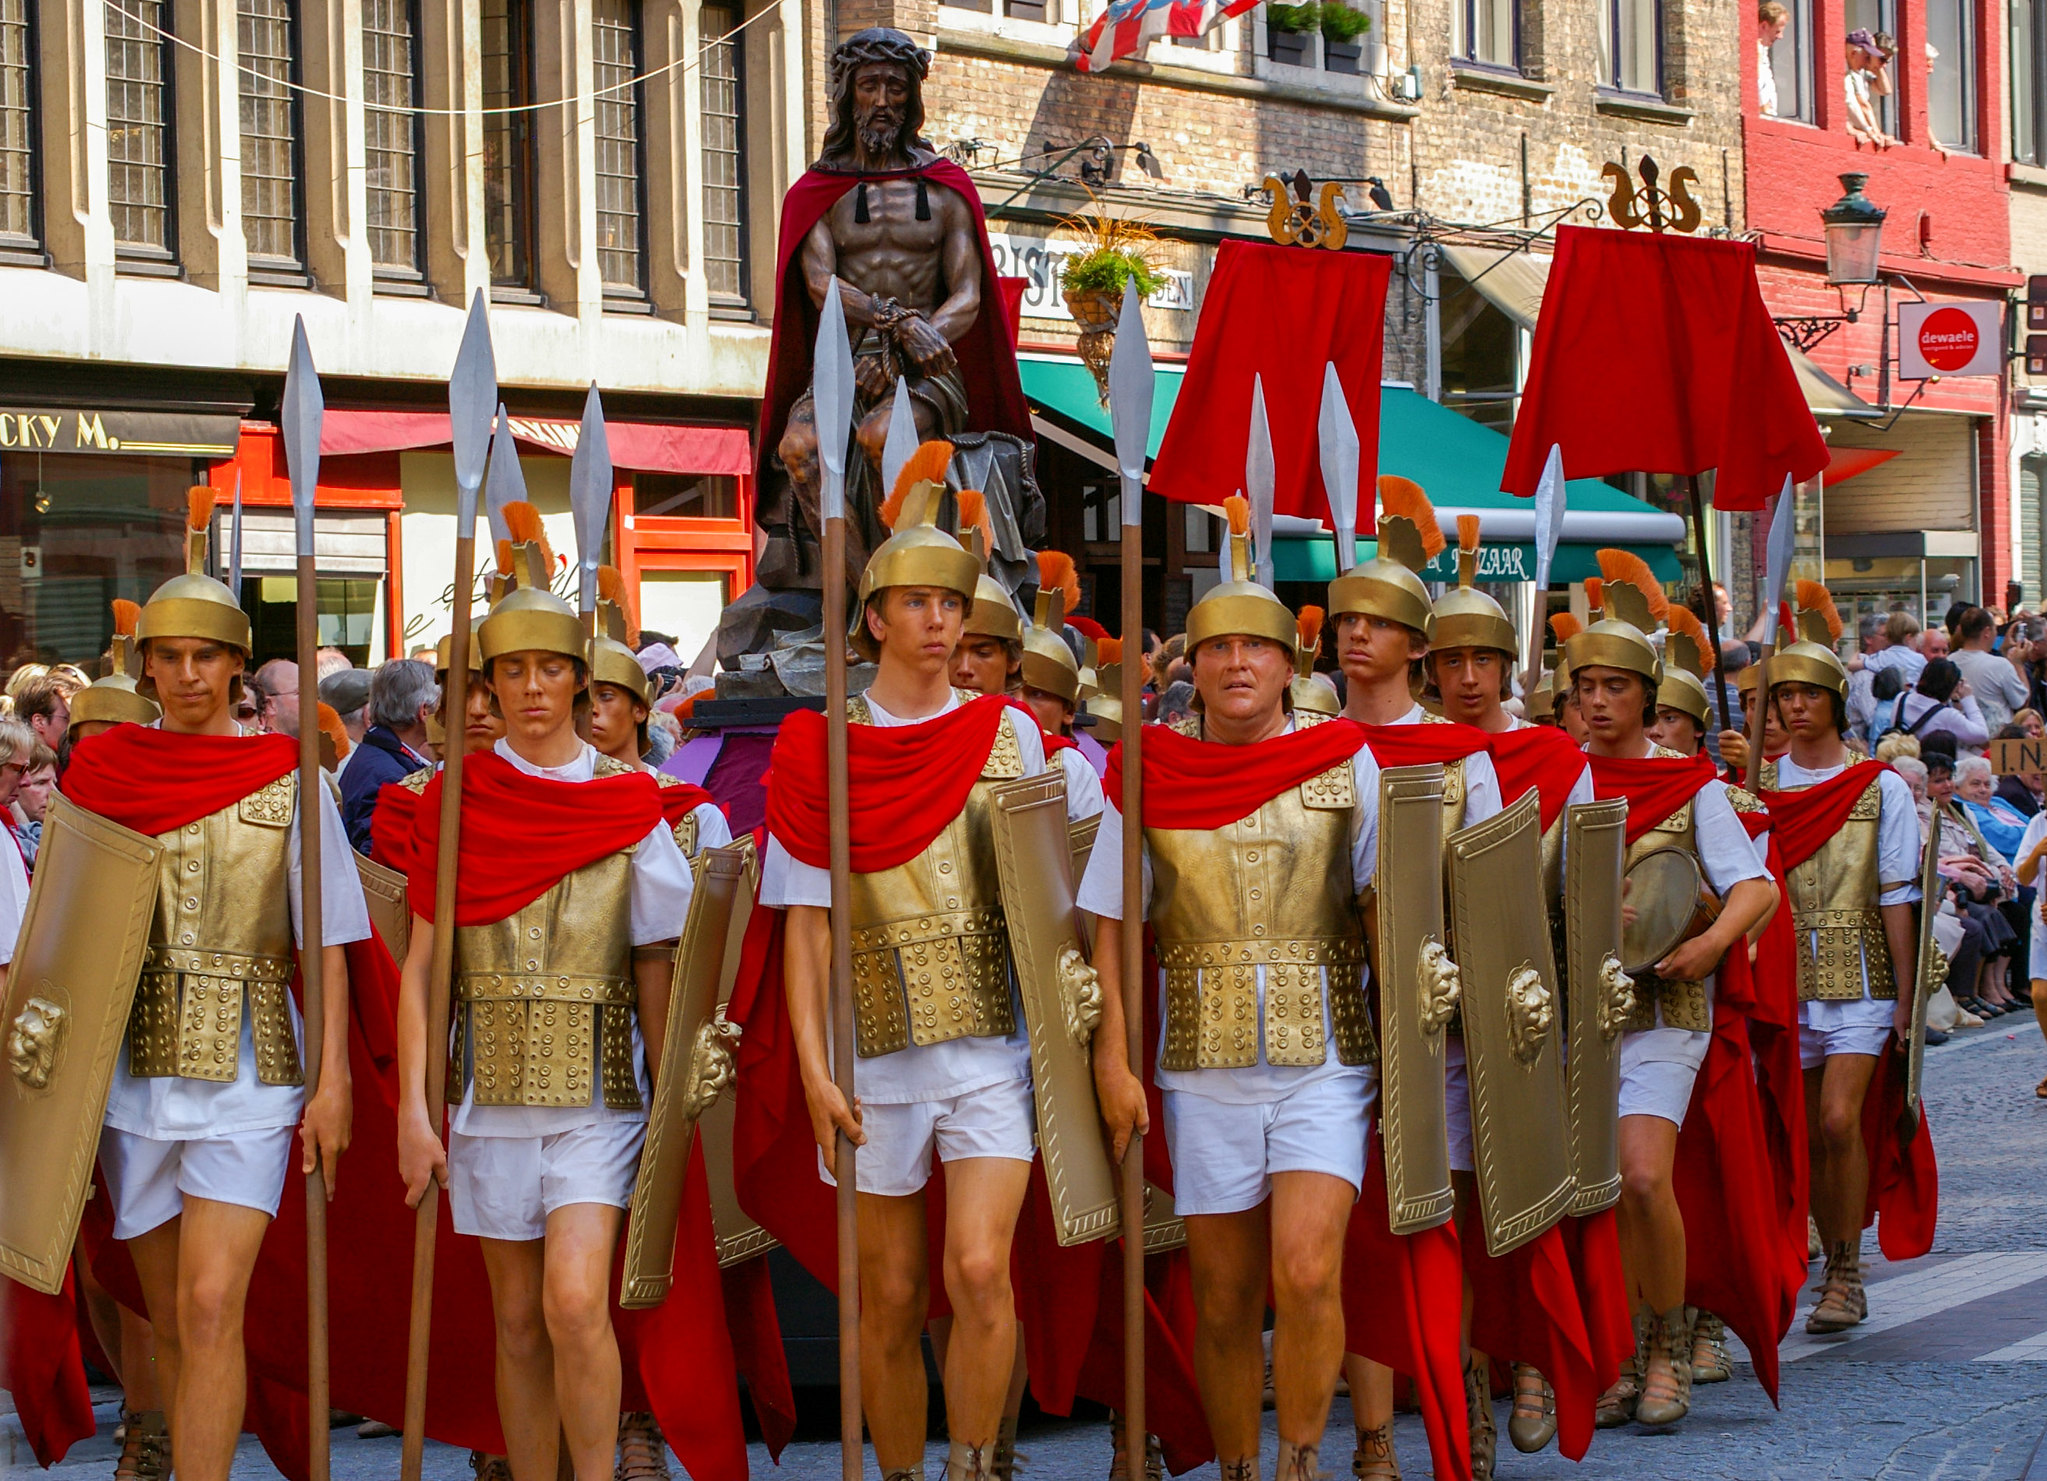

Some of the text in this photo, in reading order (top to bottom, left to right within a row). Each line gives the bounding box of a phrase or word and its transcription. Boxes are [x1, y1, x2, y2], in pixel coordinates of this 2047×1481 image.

[1921, 330, 1975, 344] dewaele
[77, 411, 120, 451] M.
[1451, 547, 1530, 580] ZAAR
